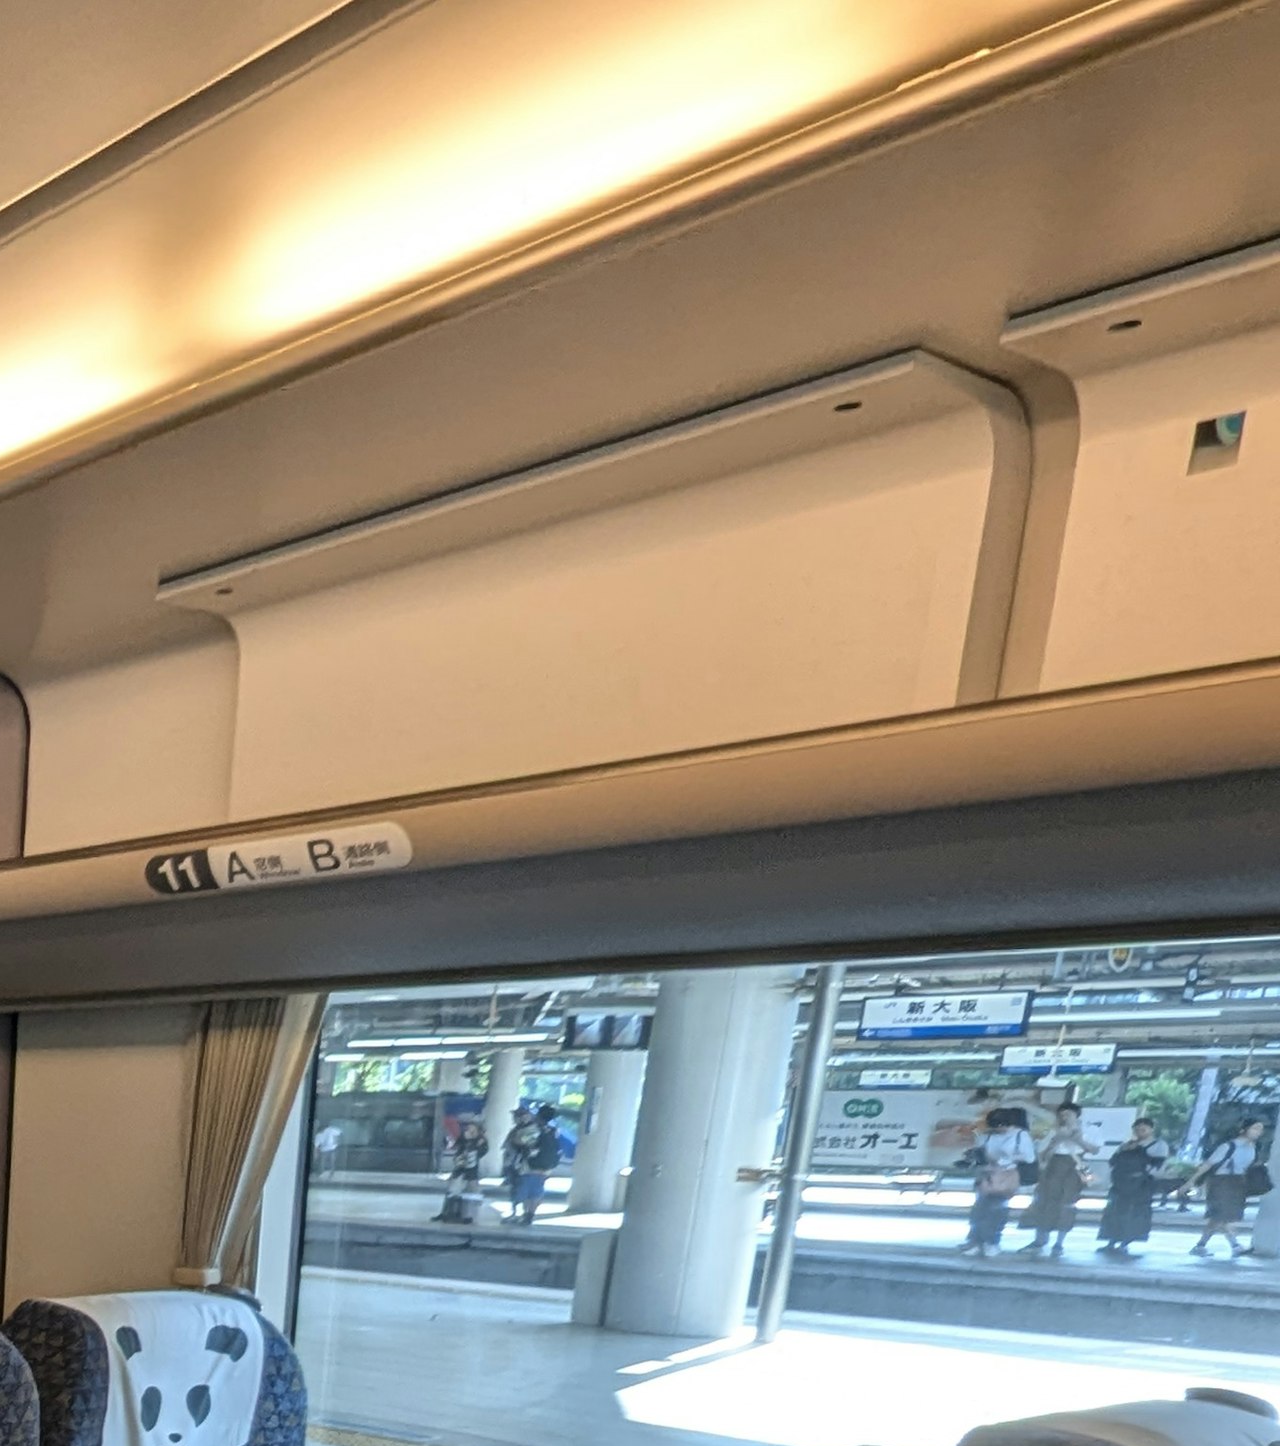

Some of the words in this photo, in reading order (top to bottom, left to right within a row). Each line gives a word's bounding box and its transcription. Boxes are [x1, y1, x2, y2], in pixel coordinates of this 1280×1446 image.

[227, 850, 256, 884] A
[307, 839, 341, 873] B
[156, 856, 204, 892] 11
[905, 998, 979, 1016] 新大阪
